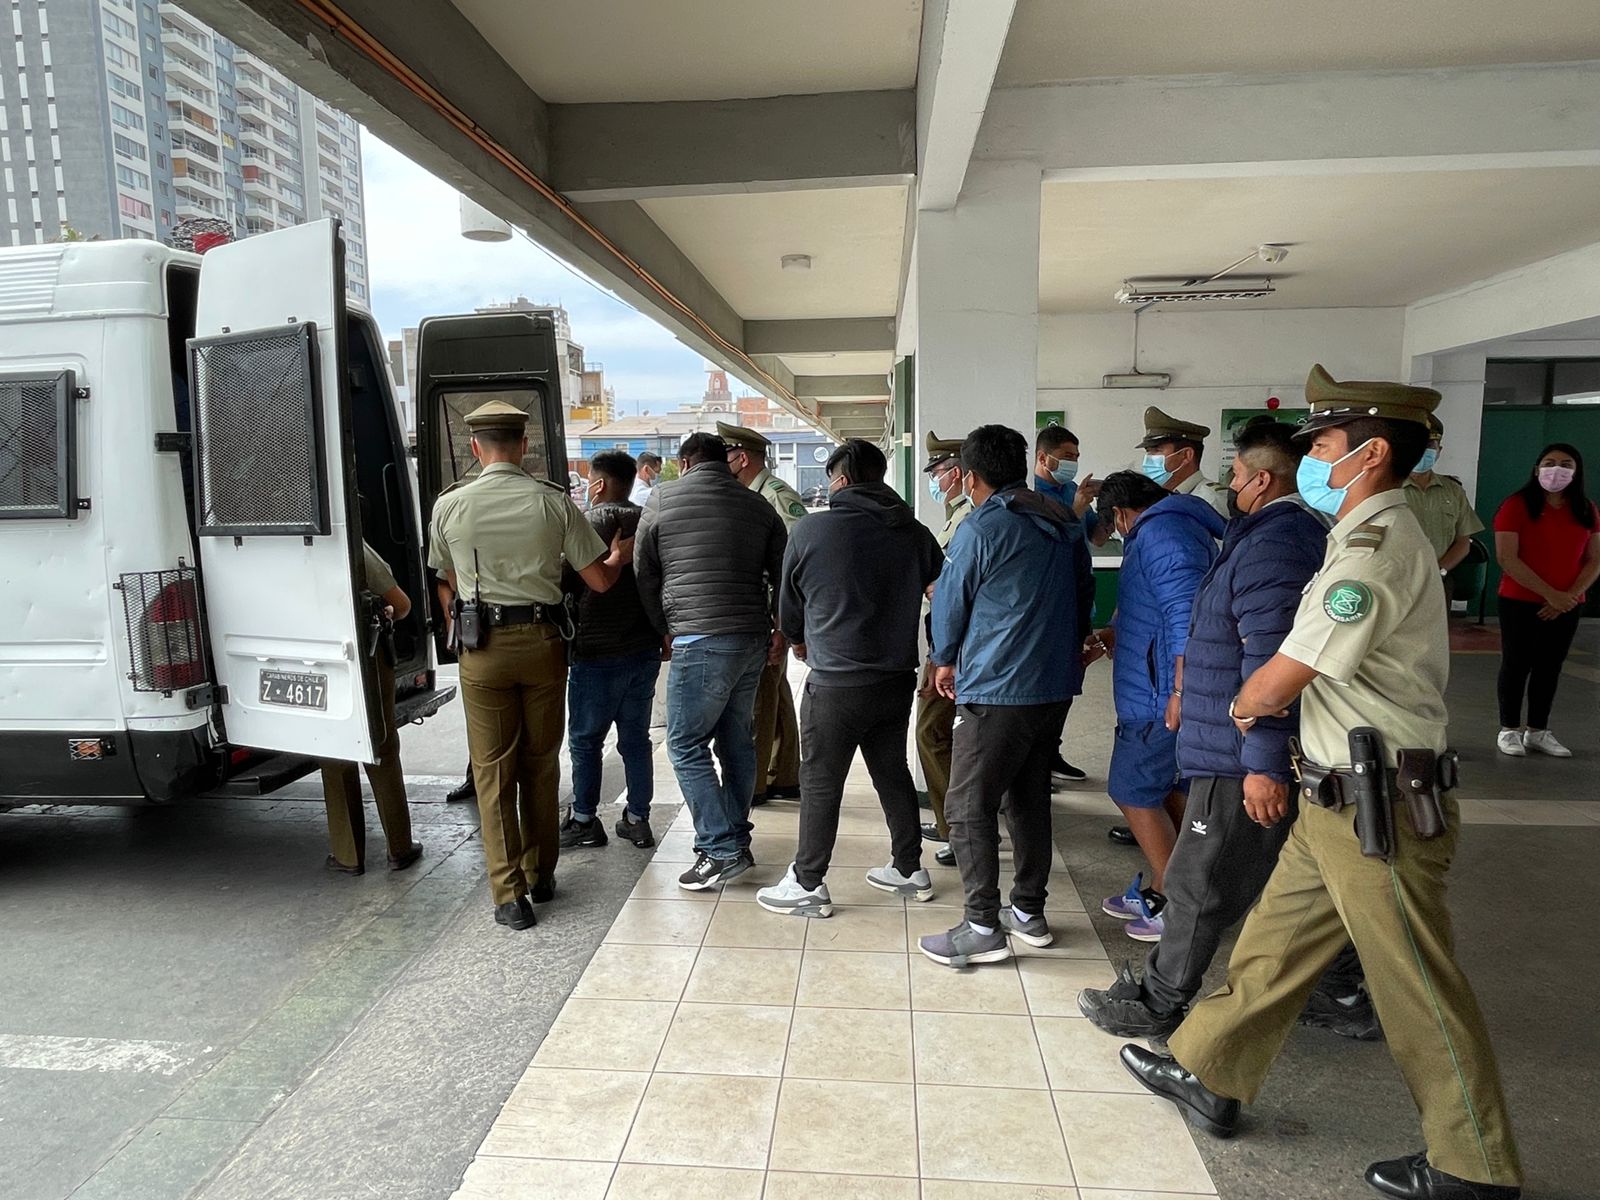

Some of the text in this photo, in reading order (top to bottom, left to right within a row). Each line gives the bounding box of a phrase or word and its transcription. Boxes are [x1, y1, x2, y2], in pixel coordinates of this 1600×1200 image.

[266, 672, 297, 682] CARABINEROS
[304, 676, 319, 684] CHILE
[263, 680, 323, 706] Z 4617
